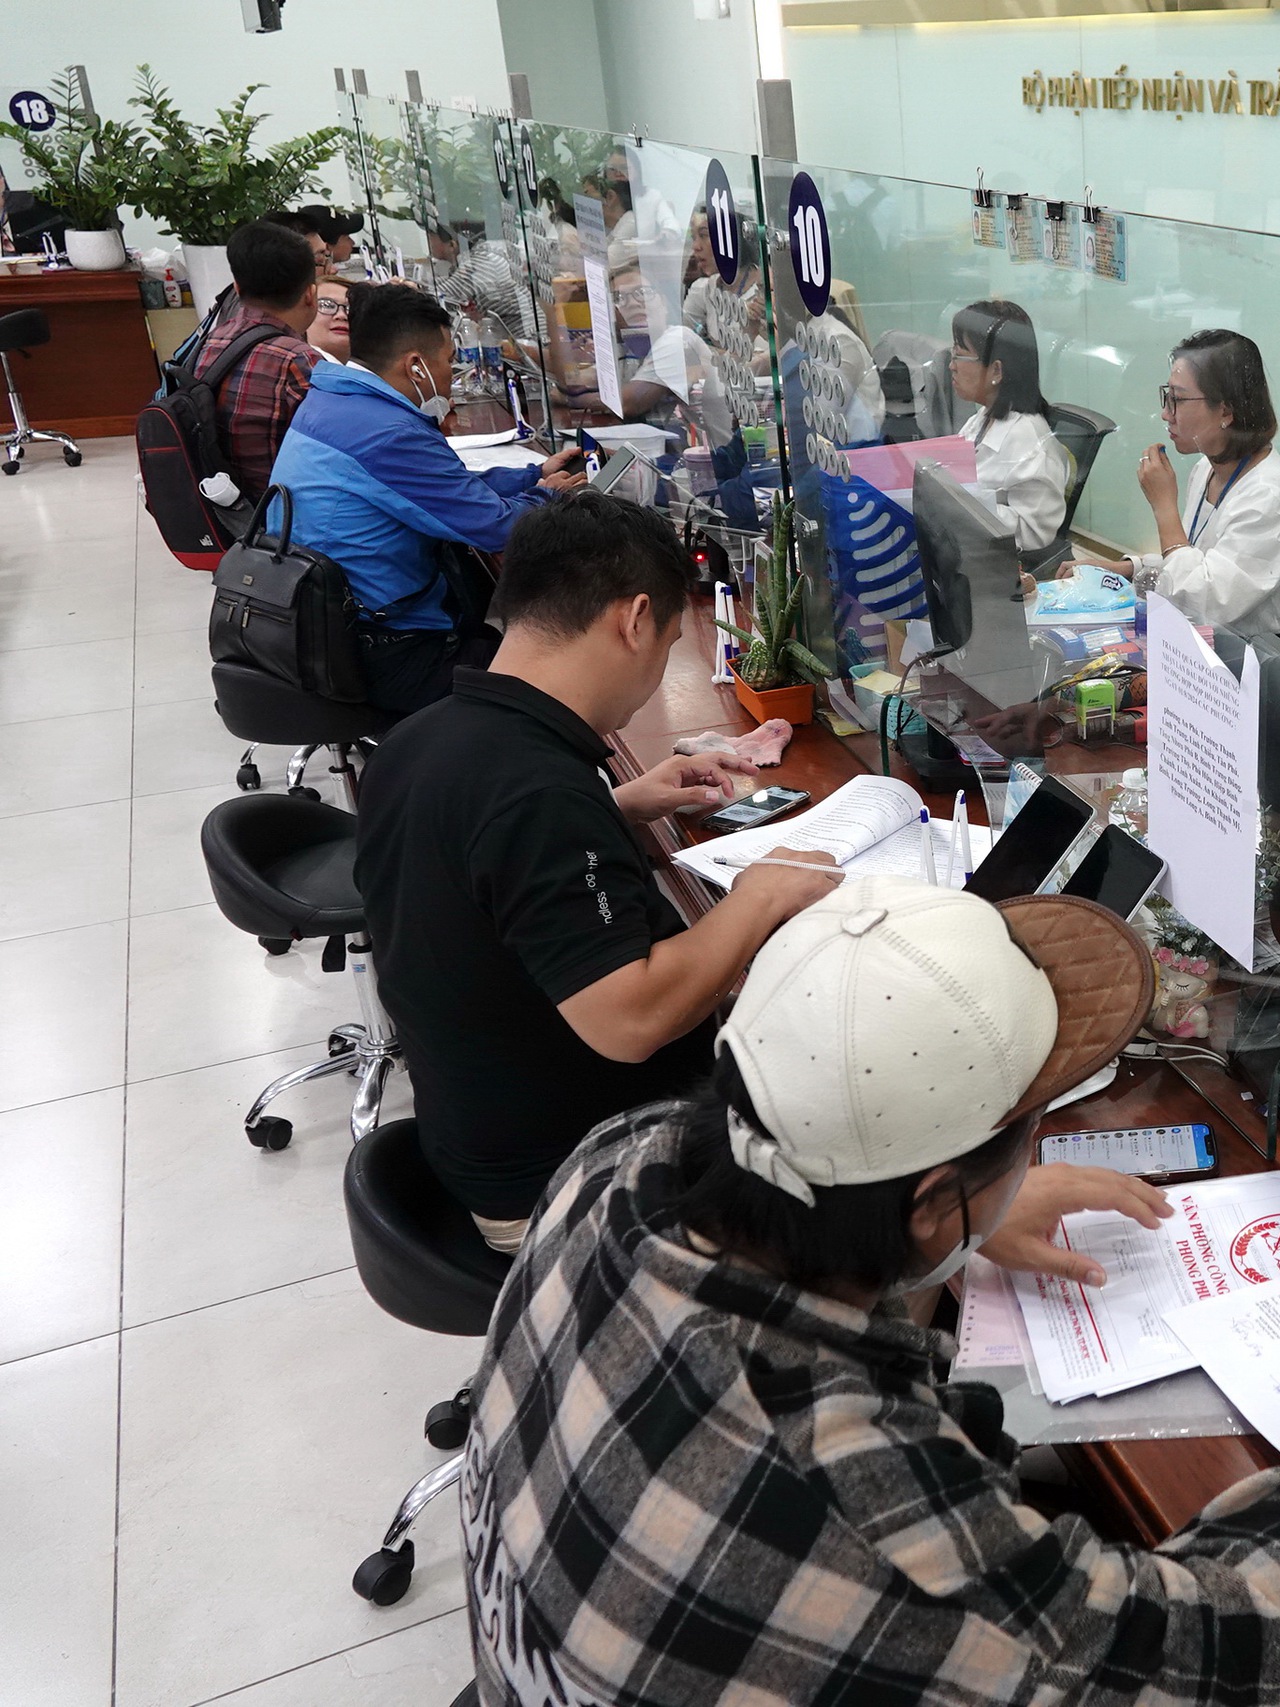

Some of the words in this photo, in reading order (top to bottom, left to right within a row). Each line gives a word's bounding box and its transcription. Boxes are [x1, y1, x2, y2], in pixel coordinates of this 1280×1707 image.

[15, 99, 49, 124] 18
[1022, 69, 1046, 114] BỘ
[1048, 70, 1098, 117] PHẬN
[1099, 64, 1139, 110] TIẾP
[1142, 70, 1204, 121] NHẬN
[1208, 69, 1244, 115] VÀ
[711, 188, 734, 259] 11
[793, 205, 825, 287] 10
[1176, 1239, 1202, 1278] PHONG
[1181, 1195, 1199, 1221] VĂN
[1190, 1222, 1216, 1264] PHÒNG
[1206, 1263, 1230, 1296] CÔNG
